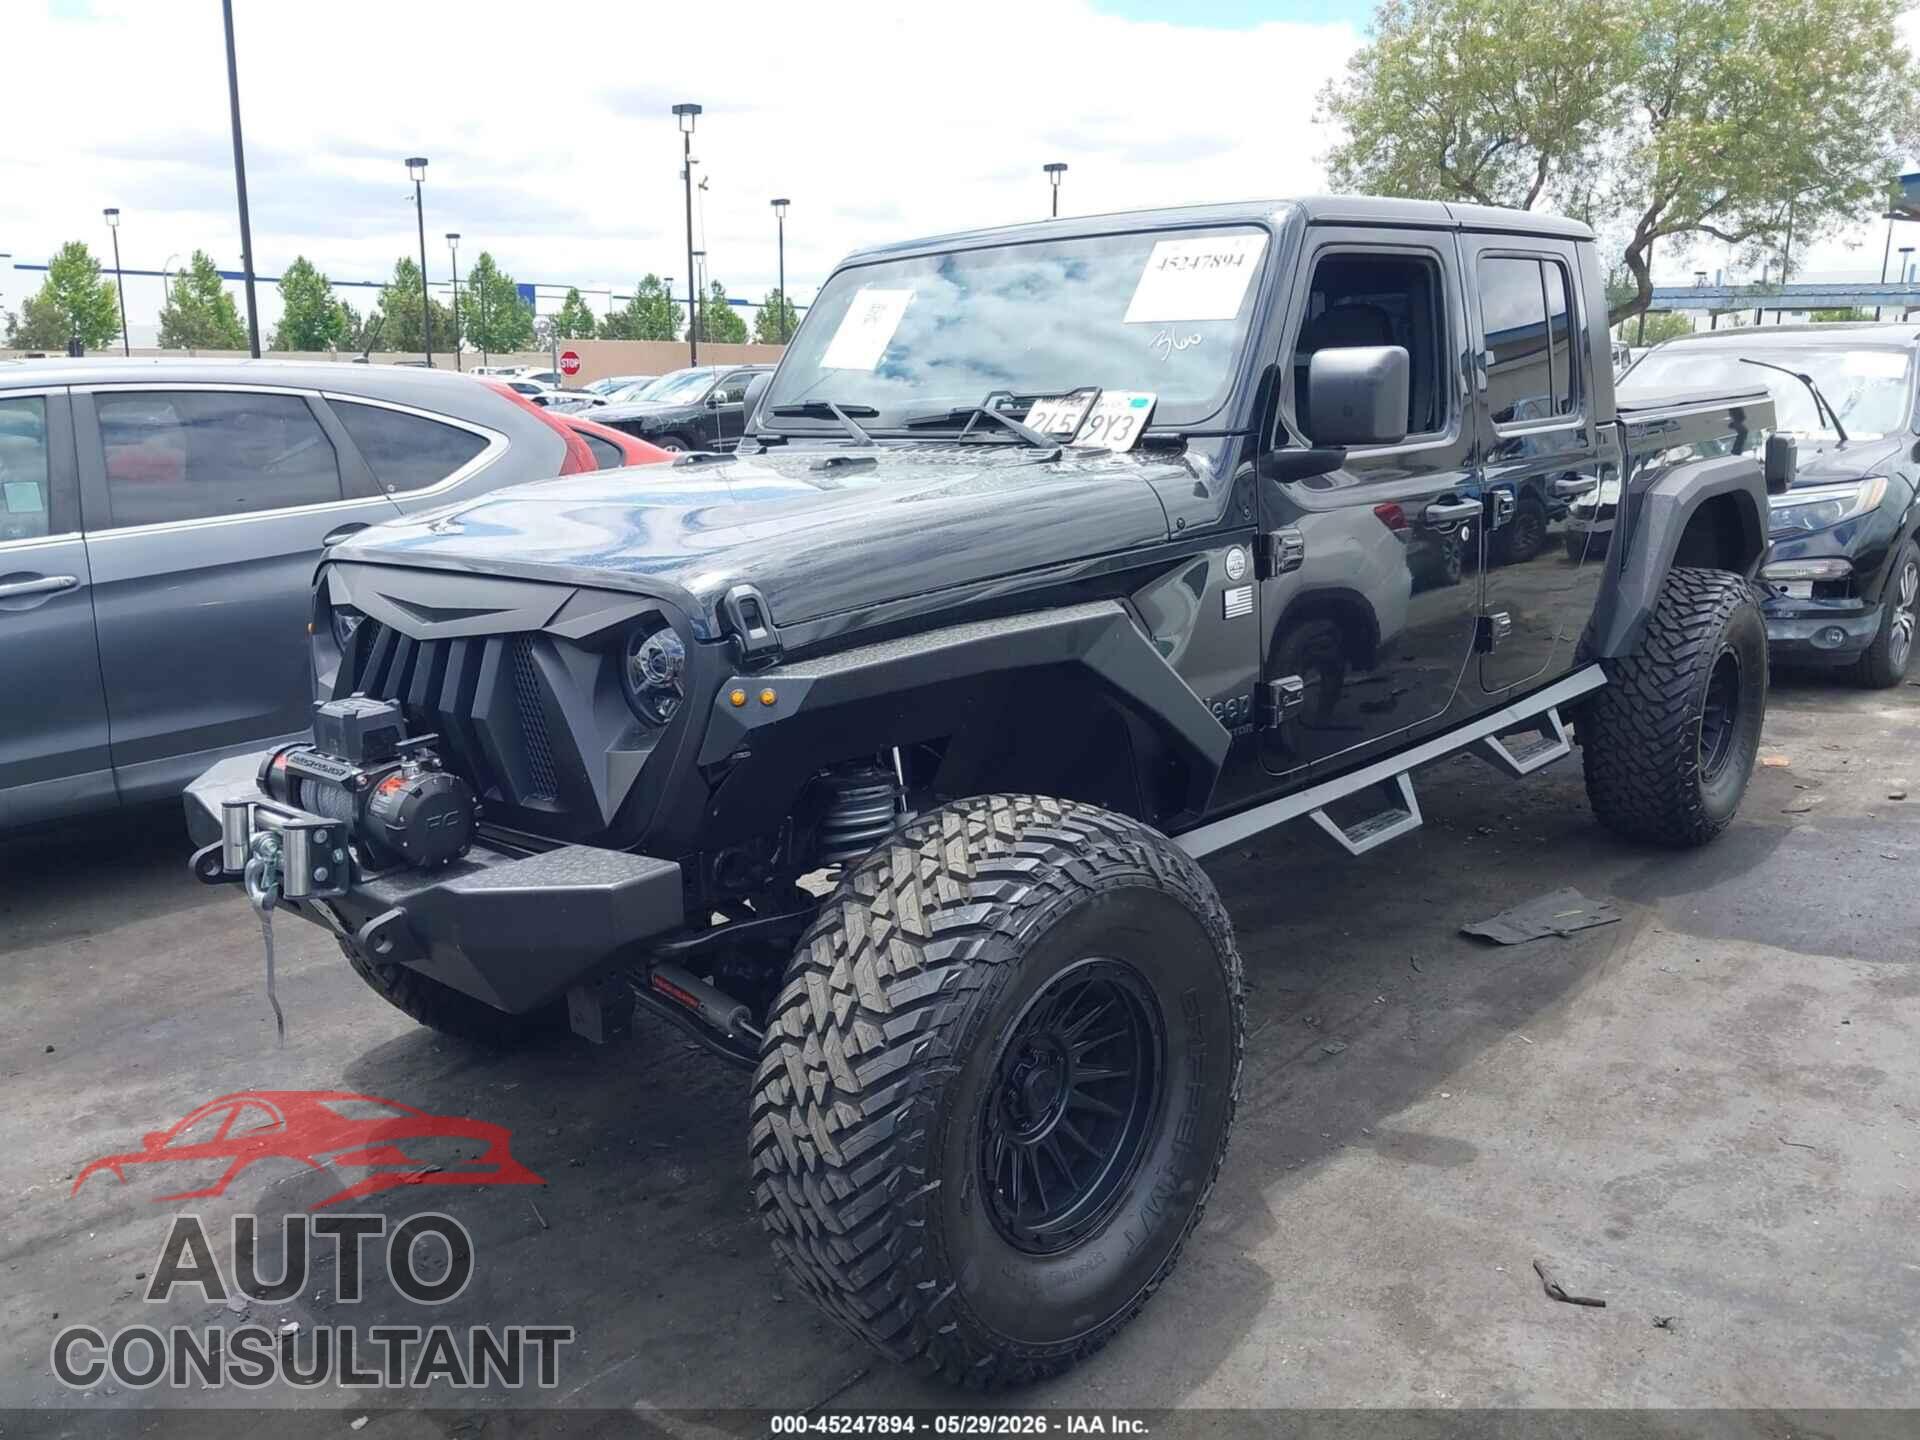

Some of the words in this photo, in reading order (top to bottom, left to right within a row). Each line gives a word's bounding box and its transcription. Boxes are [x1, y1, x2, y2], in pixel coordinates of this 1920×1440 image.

[1156, 253, 1245, 271] 45247894
[560, 358, 580, 369] STOP
[1030, 411, 1135, 441] 2459Y3
